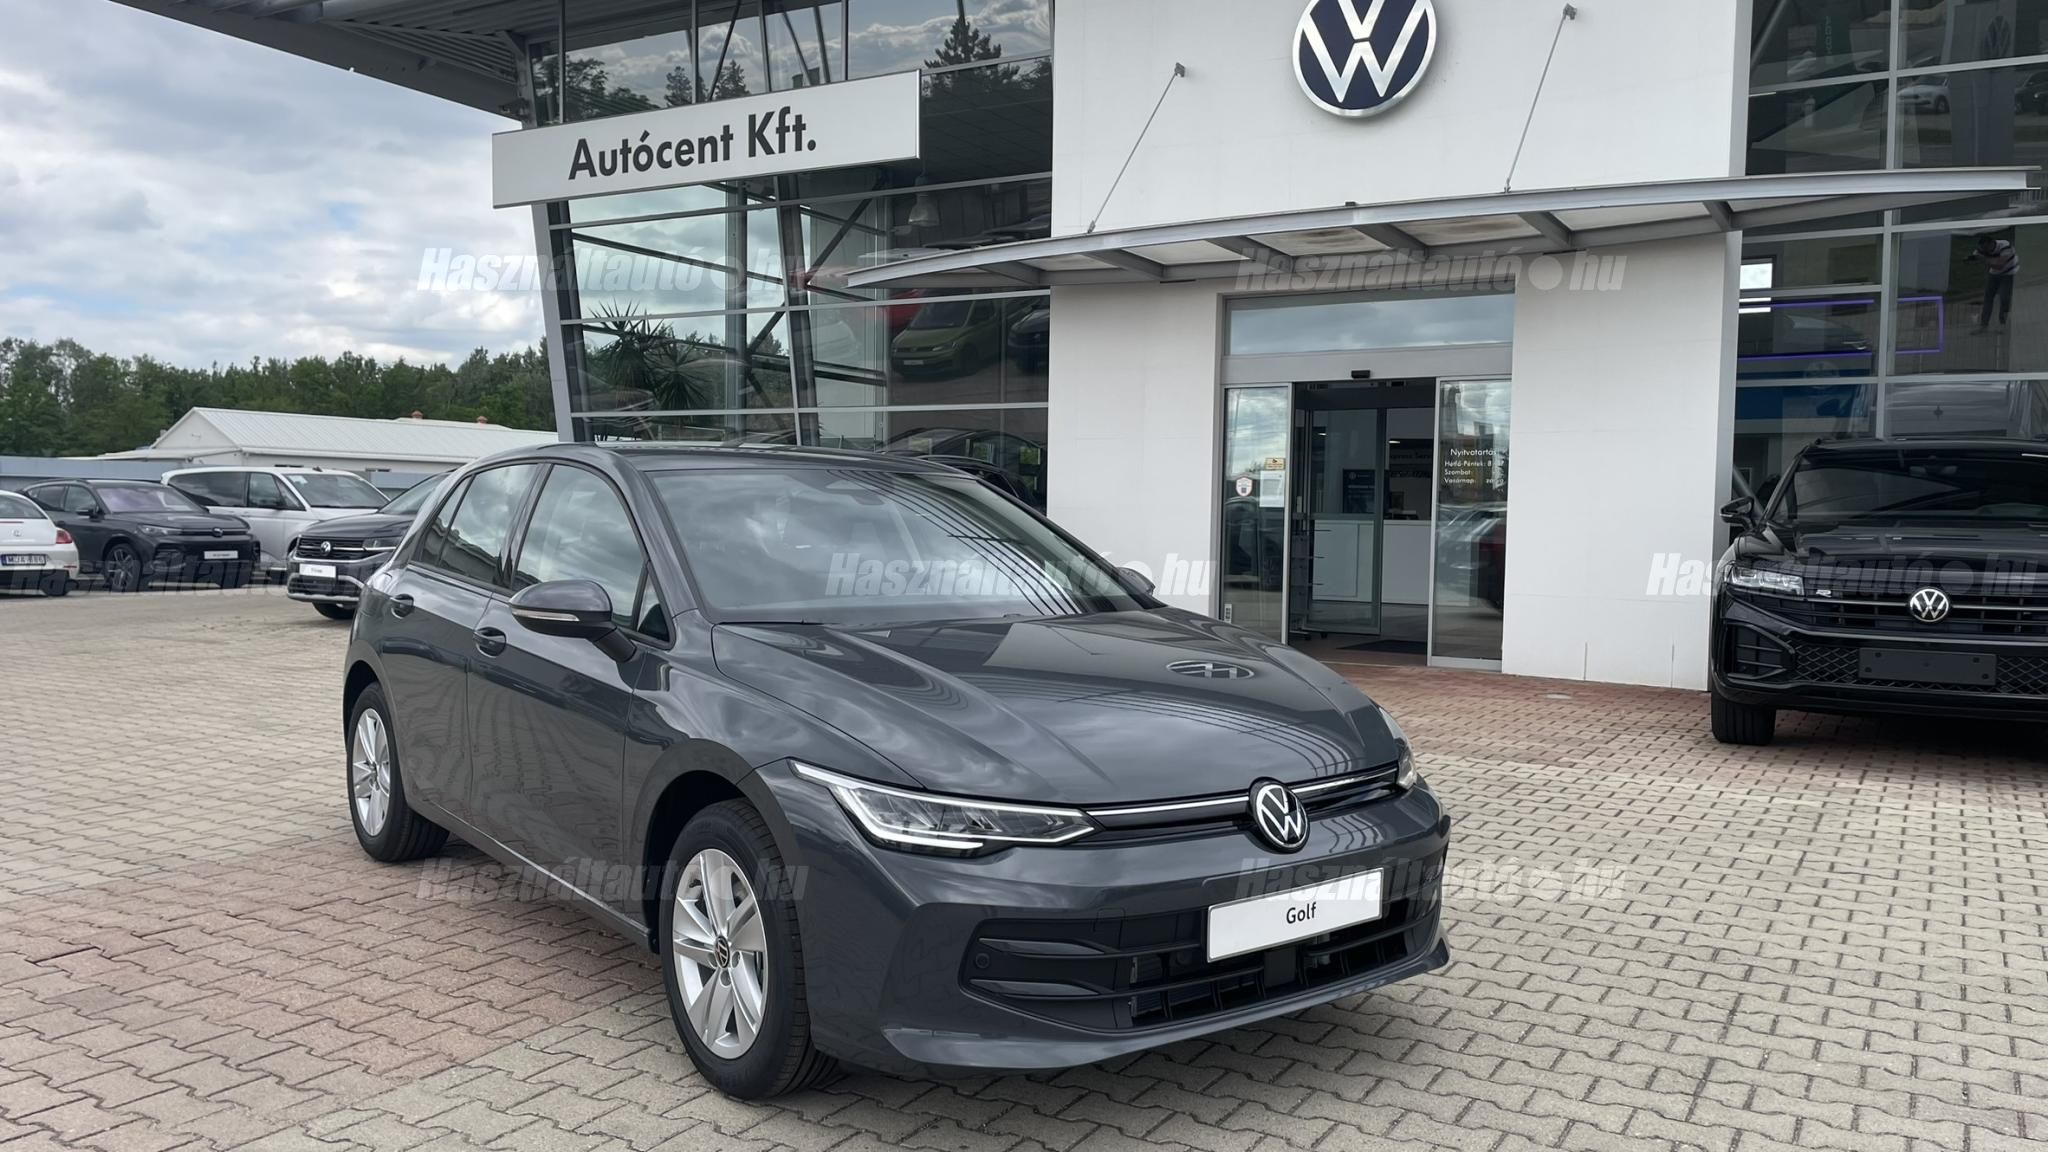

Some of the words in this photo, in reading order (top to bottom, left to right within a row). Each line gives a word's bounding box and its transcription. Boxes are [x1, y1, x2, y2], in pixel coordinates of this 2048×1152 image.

[568, 125, 733, 180] Autócent
[748, 106, 816, 157] Kft.
[1286, 902, 1317, 924] Golf
